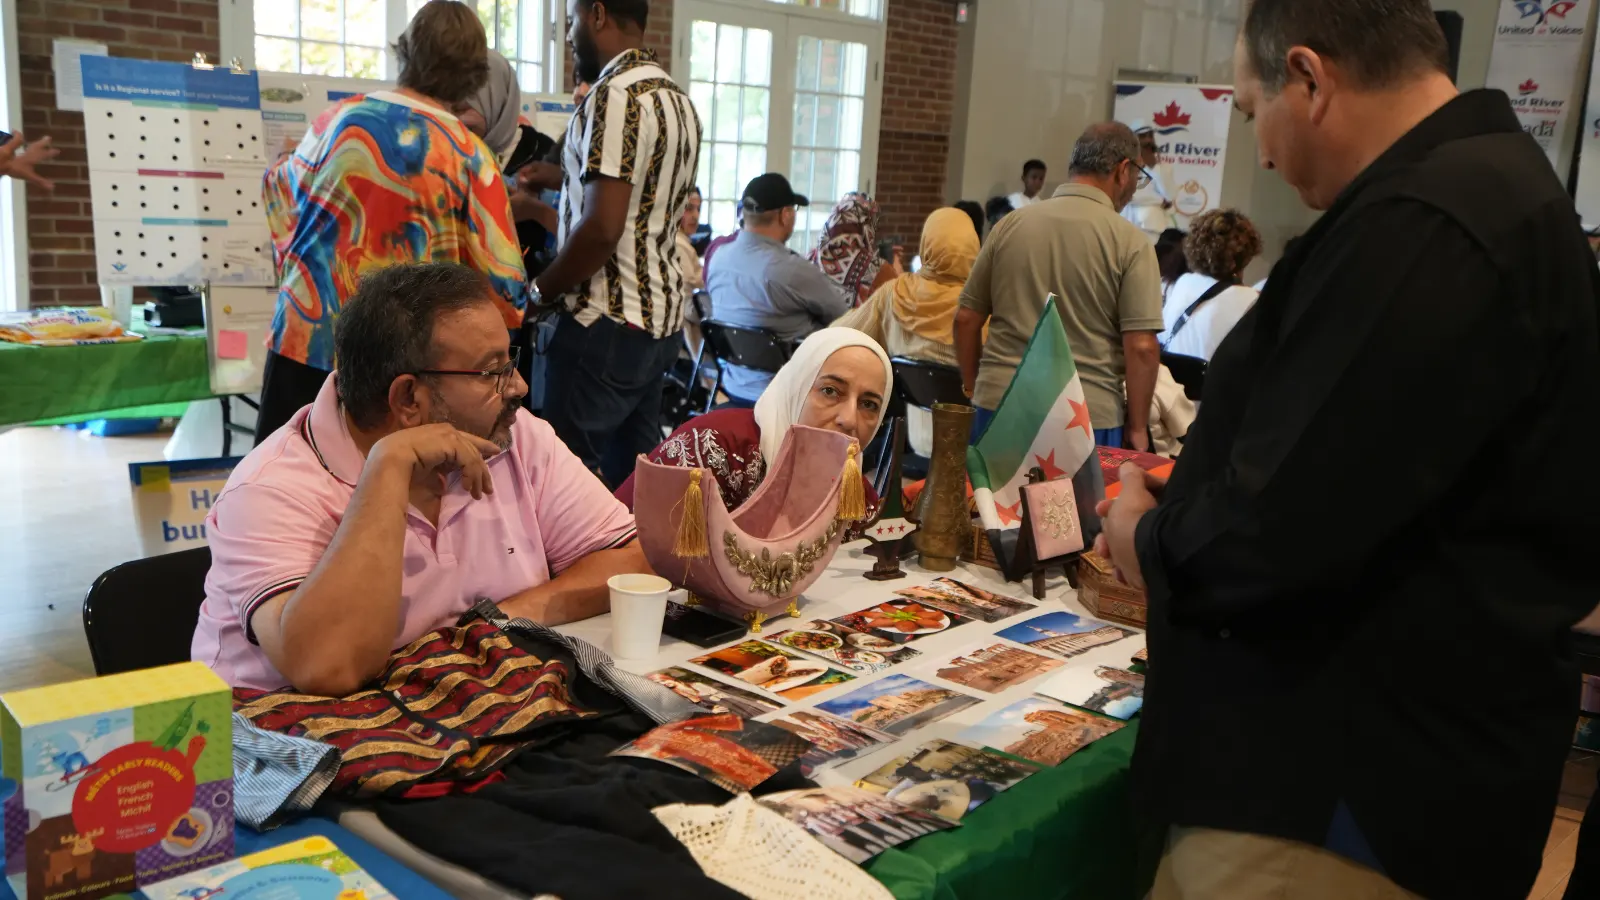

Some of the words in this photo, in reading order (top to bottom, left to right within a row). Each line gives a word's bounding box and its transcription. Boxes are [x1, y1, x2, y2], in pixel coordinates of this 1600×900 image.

[1498, 24, 1535, 35] United
[1549, 25, 1584, 35] Voices
[94, 83, 102, 91] Is
[116, 84, 149, 95] Regional
[150, 87, 180, 97] service?
[1530, 97, 1565, 107] River
[1174, 143, 1220, 157] River
[1178, 156, 1217, 168] Society
[109, 759, 144, 777] EARLY
[144, 757, 184, 782] READERS
[117, 780, 154, 796] English
[118, 792, 154, 807] French
[120, 803, 152, 818] Michif
[44, 889, 77, 900] Animals
[81, 880, 111, 893] Colours
[114, 874, 134, 884] Food
